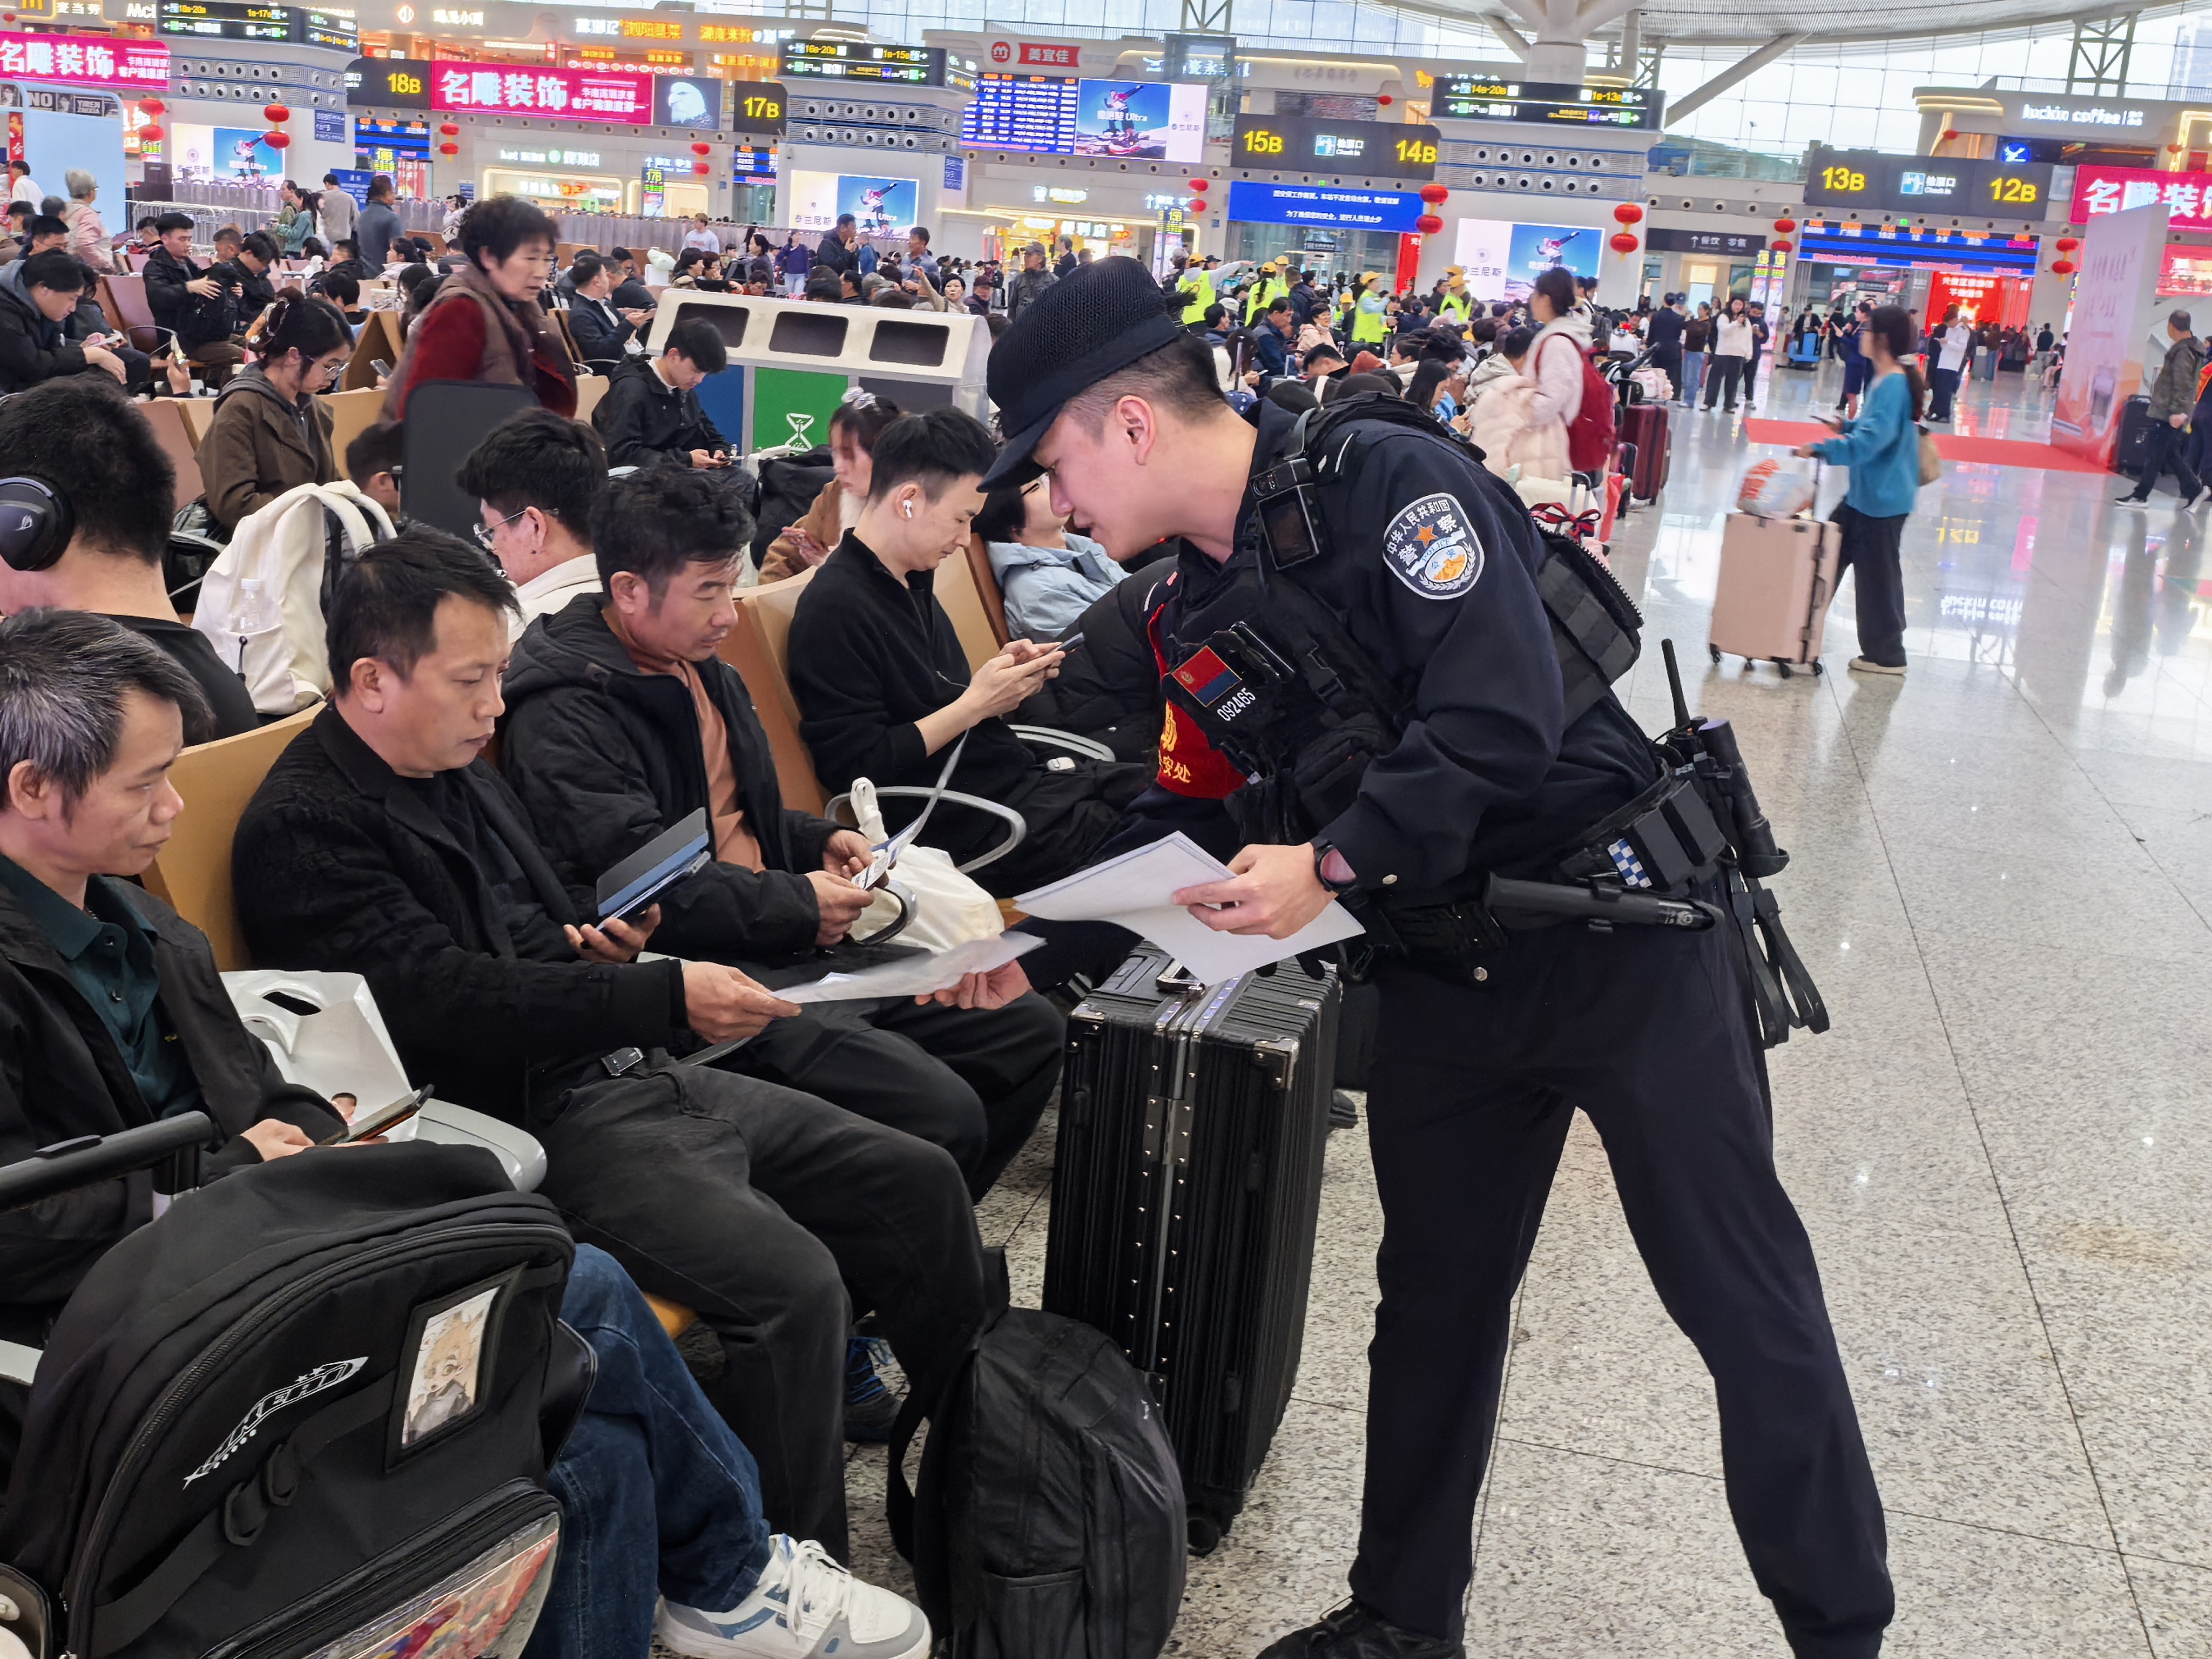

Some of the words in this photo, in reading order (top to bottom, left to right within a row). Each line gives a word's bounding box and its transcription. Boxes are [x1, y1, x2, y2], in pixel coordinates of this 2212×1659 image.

[56, 2, 101, 15] 麦当劳
[126, 3, 156, 18] Mc
[0, 40, 114, 79] 名雕装饰
[1027, 48, 1069, 64] 美宜佳
[387, 73, 421, 93] 18B
[439, 70, 567, 111] 名雕装饰
[29, 92, 53, 107] NO
[744, 97, 780, 119] 17B
[2023, 104, 2069, 121] luckin
[2072, 108, 2120, 125] coffee
[1244, 130, 1283, 153] 15B
[1396, 140, 1437, 163] 14B
[1822, 166, 1865, 192] 13B
[1991, 177, 2036, 203] 12B
[1386, 500, 1451, 555] 中华人民共和国
[1421, 538, 1451, 562] POLICE
[1217, 687, 1256, 721] 092465
[1158, 749, 1191, 783] 安处
